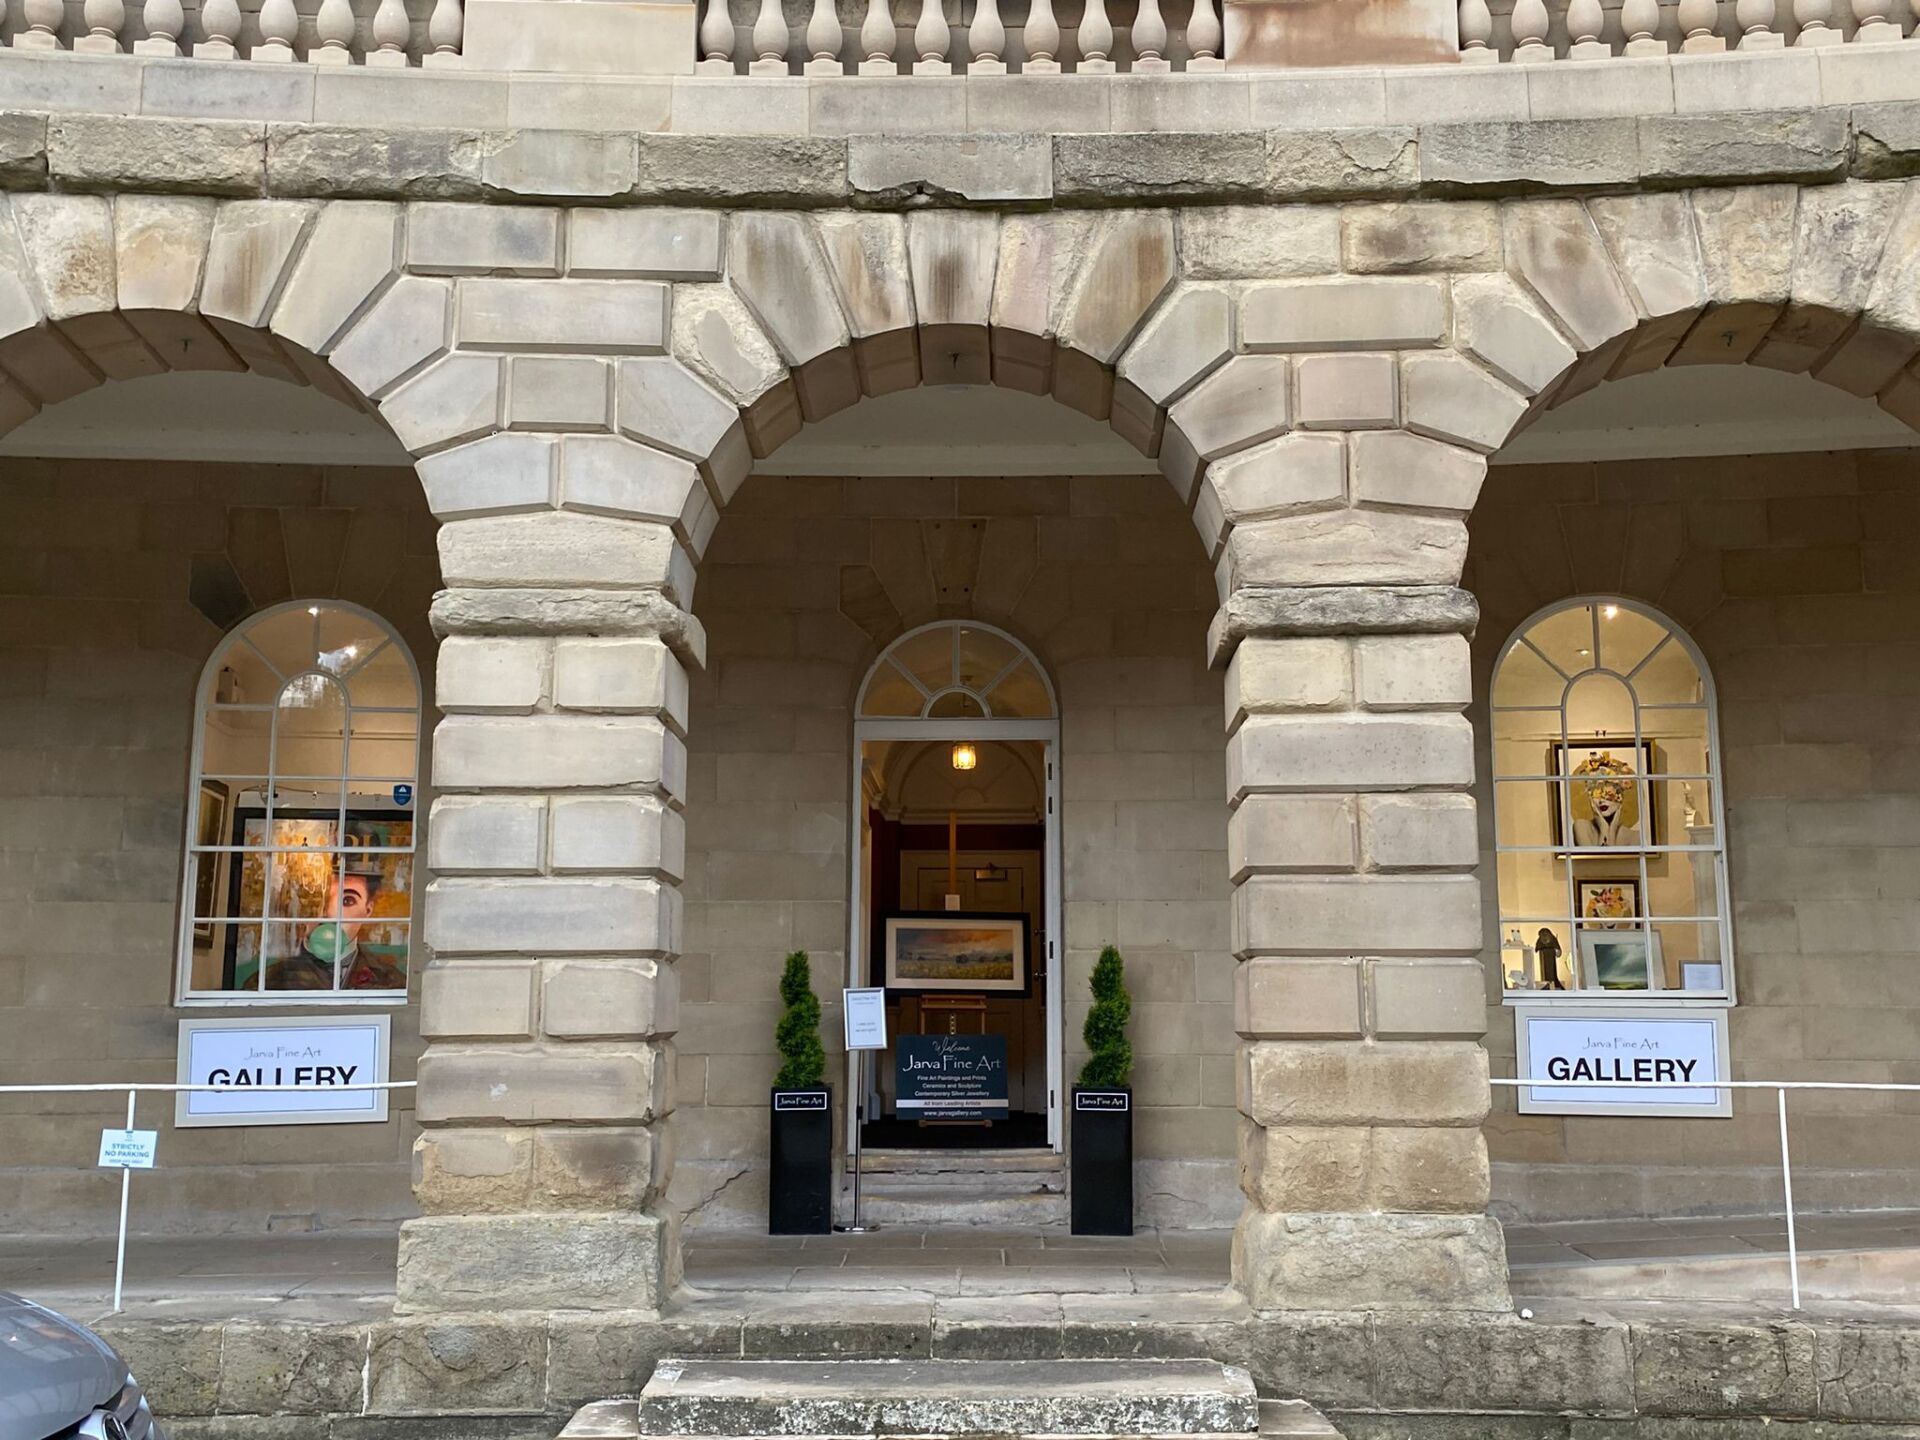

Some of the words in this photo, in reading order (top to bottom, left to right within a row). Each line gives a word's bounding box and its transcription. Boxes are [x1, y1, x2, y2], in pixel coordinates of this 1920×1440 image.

[932, 1036, 971, 1055] Welcome
[1583, 1036, 1612, 1050] Jarva
[1614, 1037, 1637, 1049] Fine
[1639, 1037, 1660, 1050] Art
[243, 1047, 274, 1060] Jarva
[276, 1046, 300, 1059] Fine
[302, 1046, 321, 1058] Art
[902, 1054, 940, 1072] Jarva
[943, 1054, 972, 1071] Fine
[975, 1055, 1001, 1071] Art
[1547, 1056, 1697, 1082] GALLERY
[811, 1097, 822, 1105] Art
[1080, 1097, 1096, 1105] Jarva
[1097, 1097, 1110, 1105] Fine
[1112, 1097, 1123, 1105] Art
